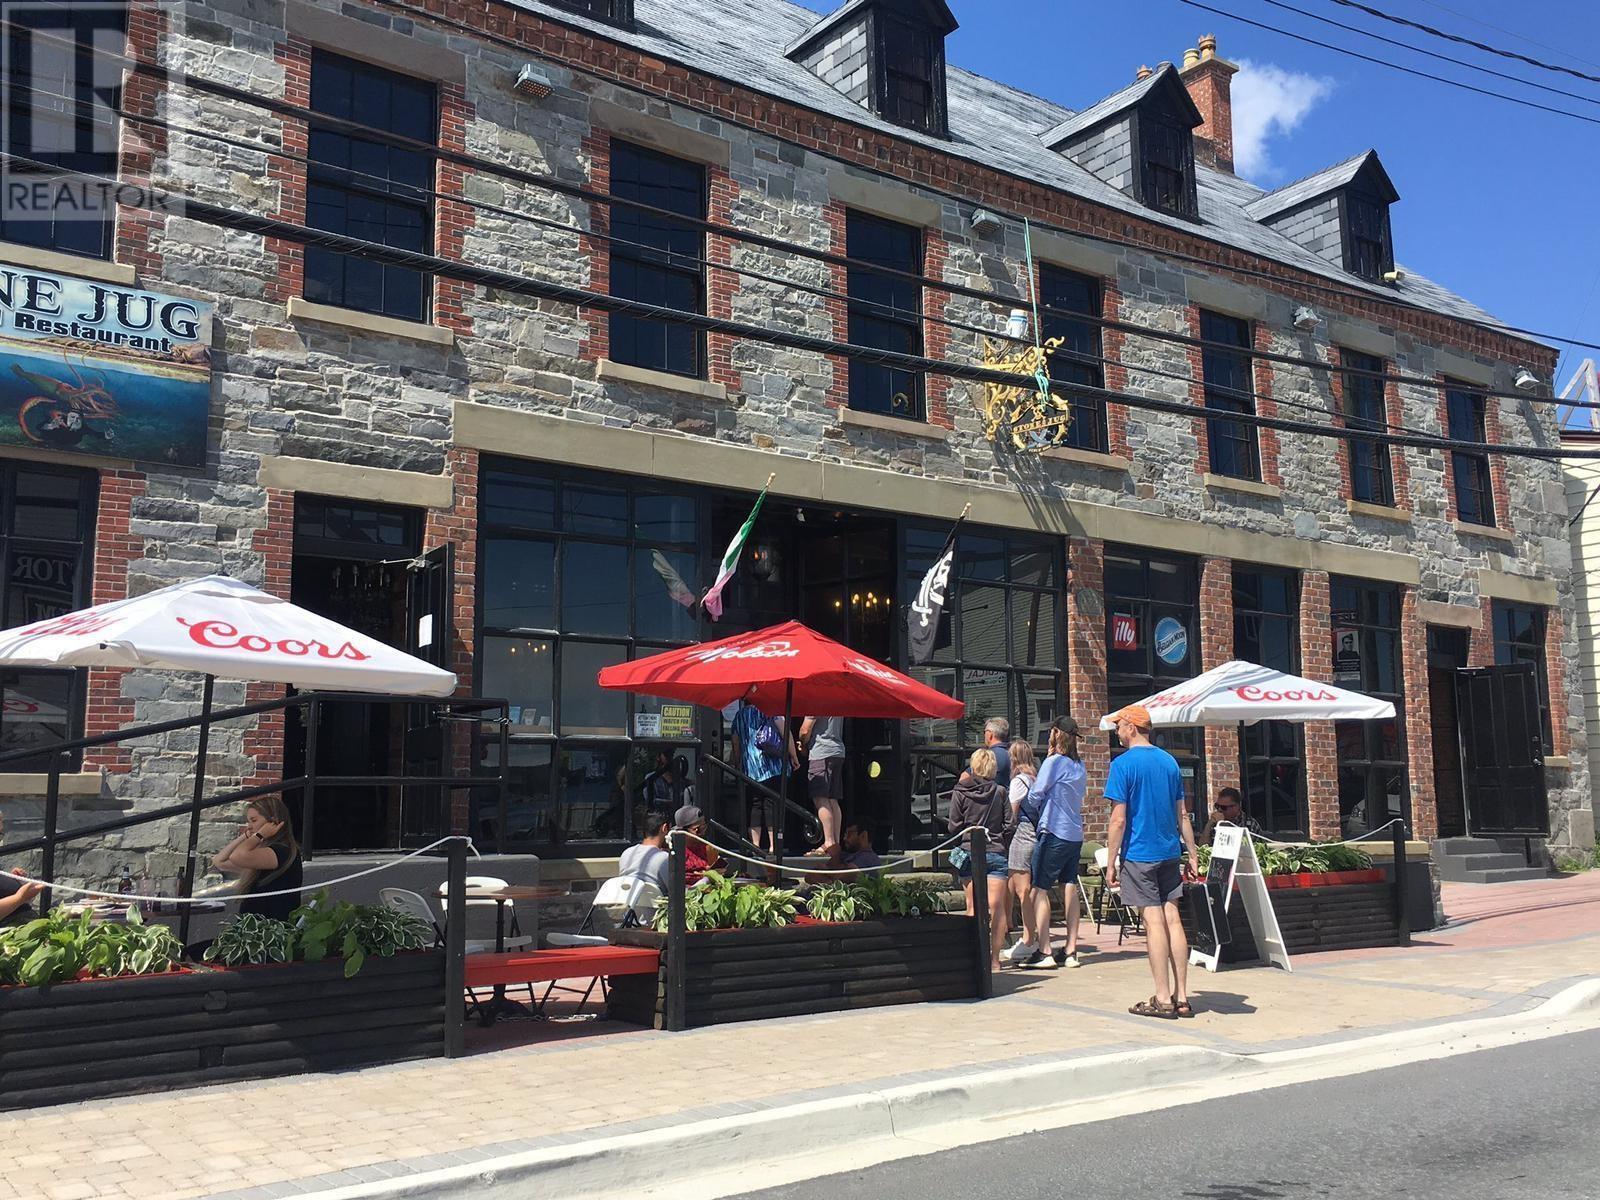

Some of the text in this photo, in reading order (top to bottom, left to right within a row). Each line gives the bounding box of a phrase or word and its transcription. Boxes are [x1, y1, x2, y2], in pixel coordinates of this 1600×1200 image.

[77, 284, 199, 339] JUG
[14, 311, 172, 353] Restaurant
[175, 616, 372, 661] Coors
[1115, 620, 1136, 647] illy
[1227, 685, 1340, 702] Coors
[663, 706, 690, 717] CAUTION
